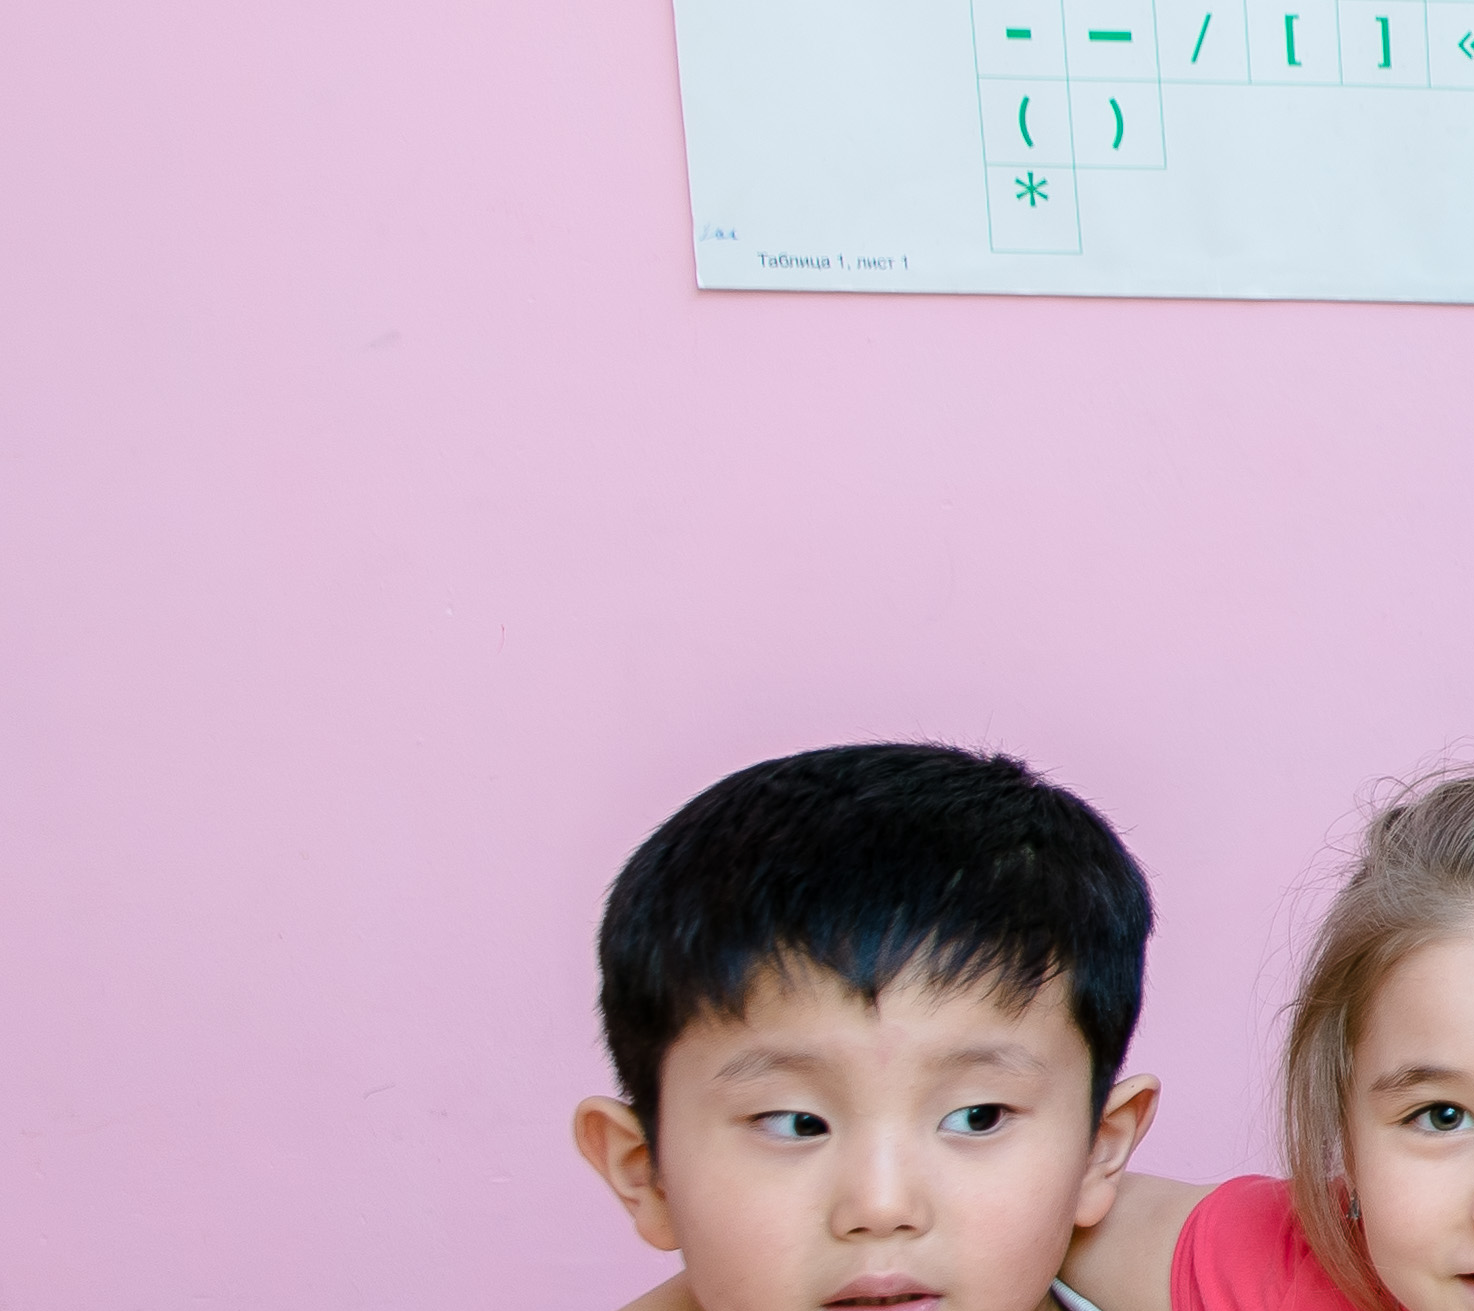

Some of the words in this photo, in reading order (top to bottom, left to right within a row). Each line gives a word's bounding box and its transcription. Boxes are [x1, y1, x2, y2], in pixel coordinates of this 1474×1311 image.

[757, 251, 830, 270] Таблица
[857, 256, 895, 270] лист
[902, 255, 908, 270] 1
